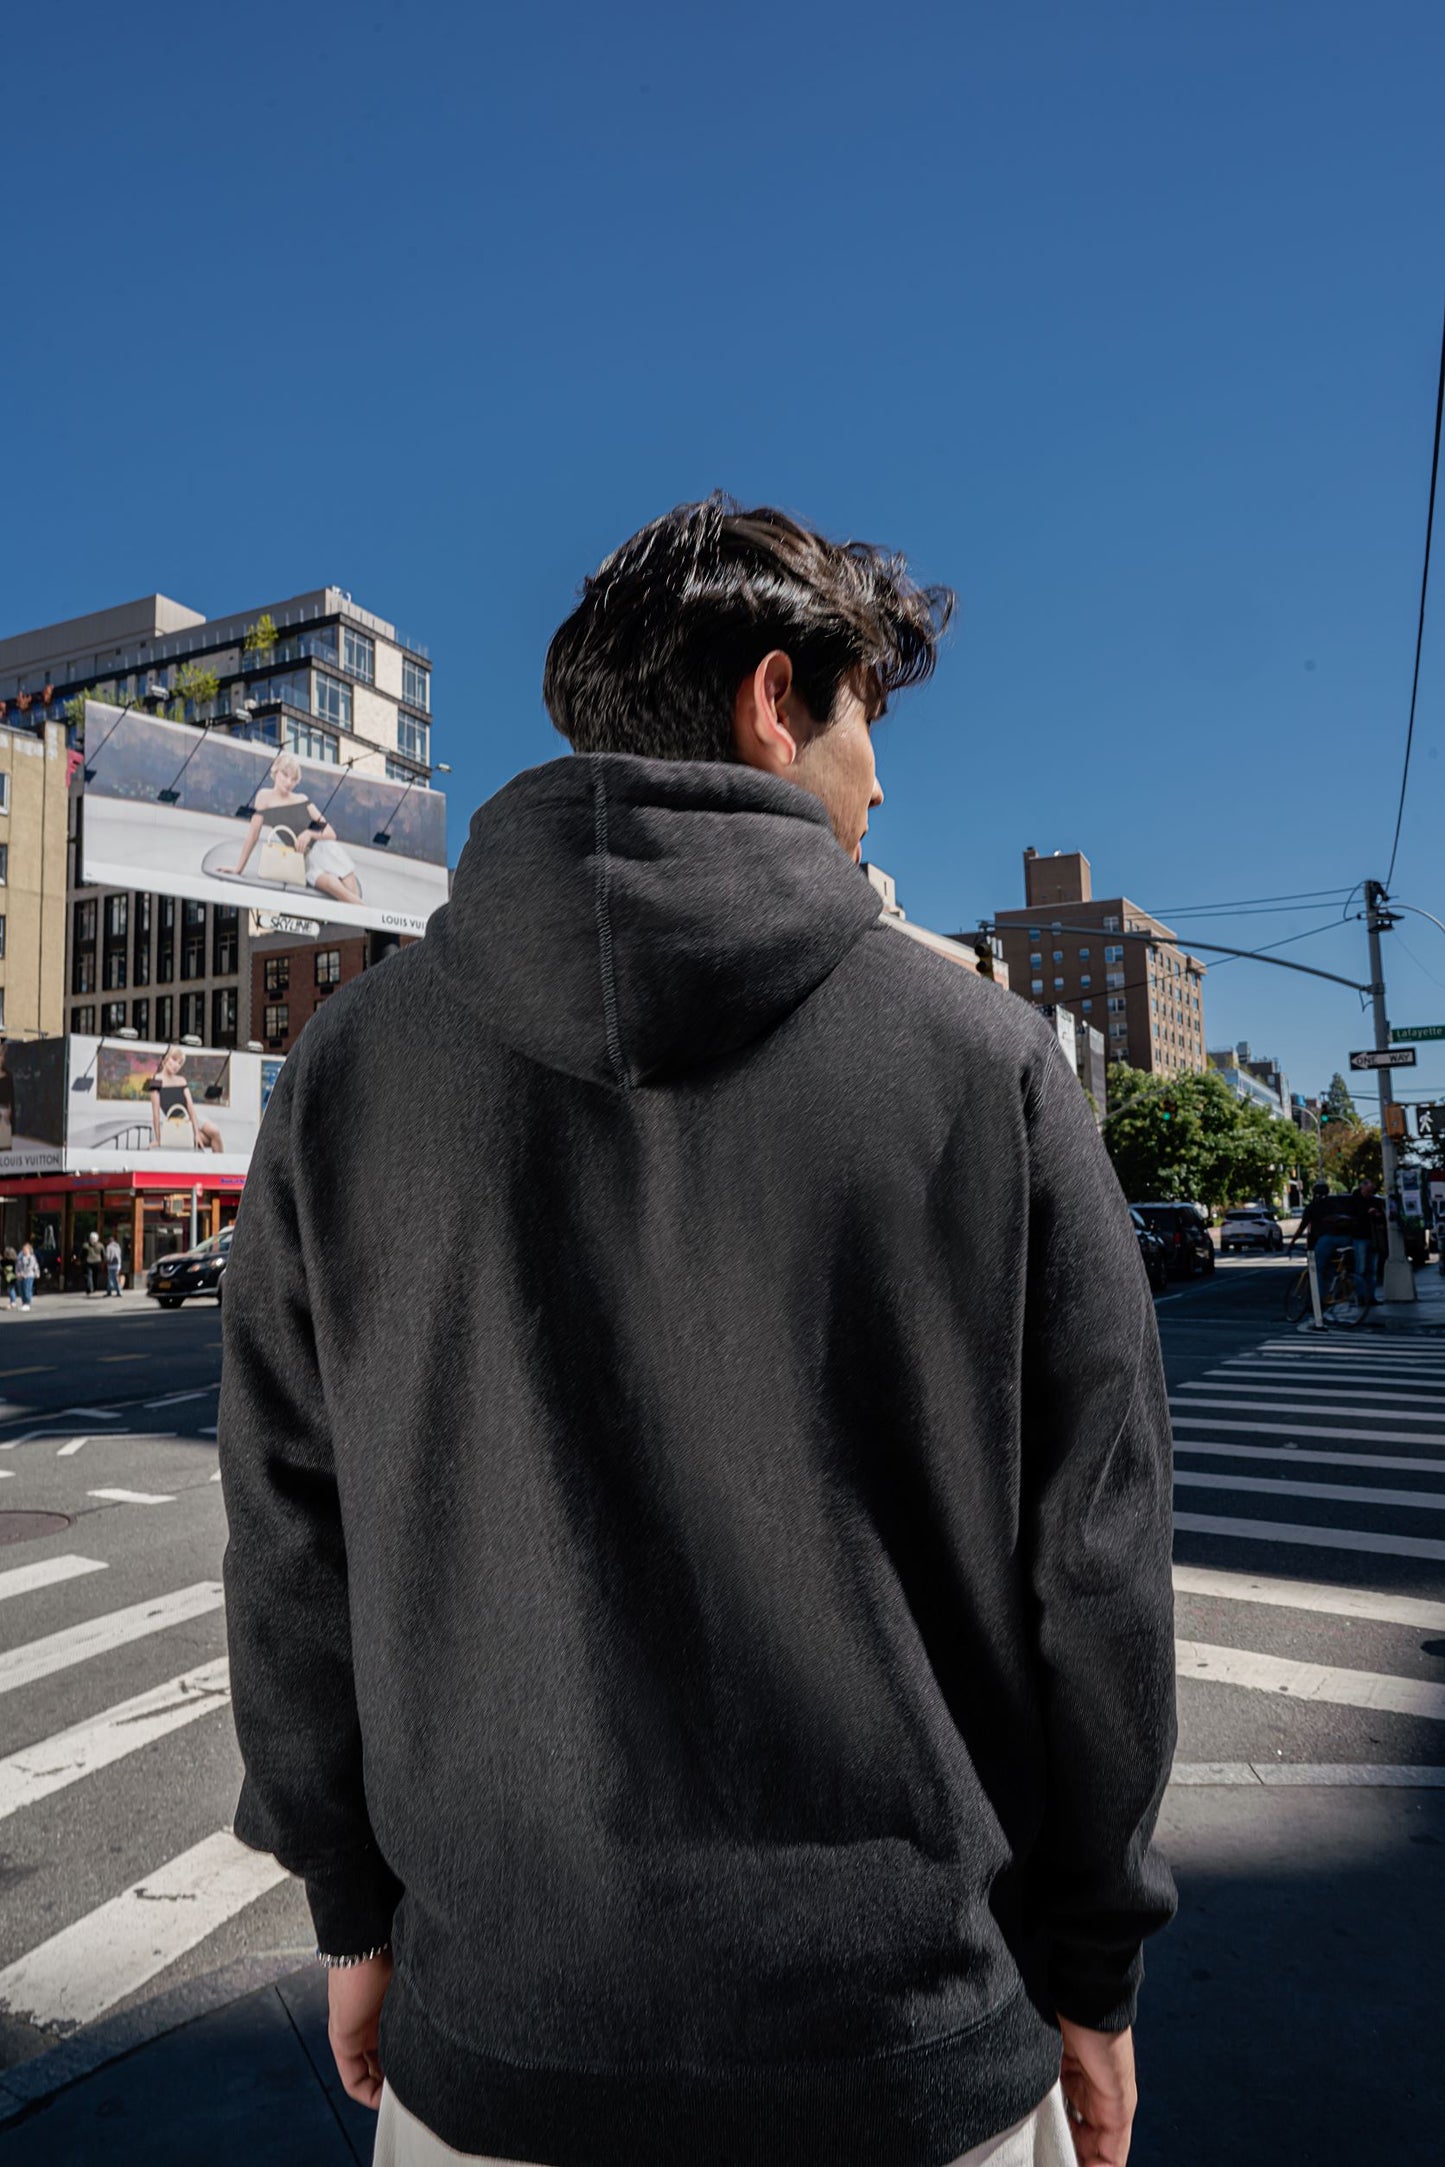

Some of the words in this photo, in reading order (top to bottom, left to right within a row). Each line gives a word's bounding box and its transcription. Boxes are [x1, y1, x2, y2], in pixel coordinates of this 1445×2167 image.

[270, 916, 313, 933] SKYLINE
[381, 913, 408, 928] LOUIS
[410, 918, 426, 930] VUI
[1397, 1027, 1442, 1038] Lafayette
[1356, 1055, 1377, 1066] ONE
[1389, 1053, 1411, 1063] WAY
[25, 1153, 60, 1167] VUITTON
